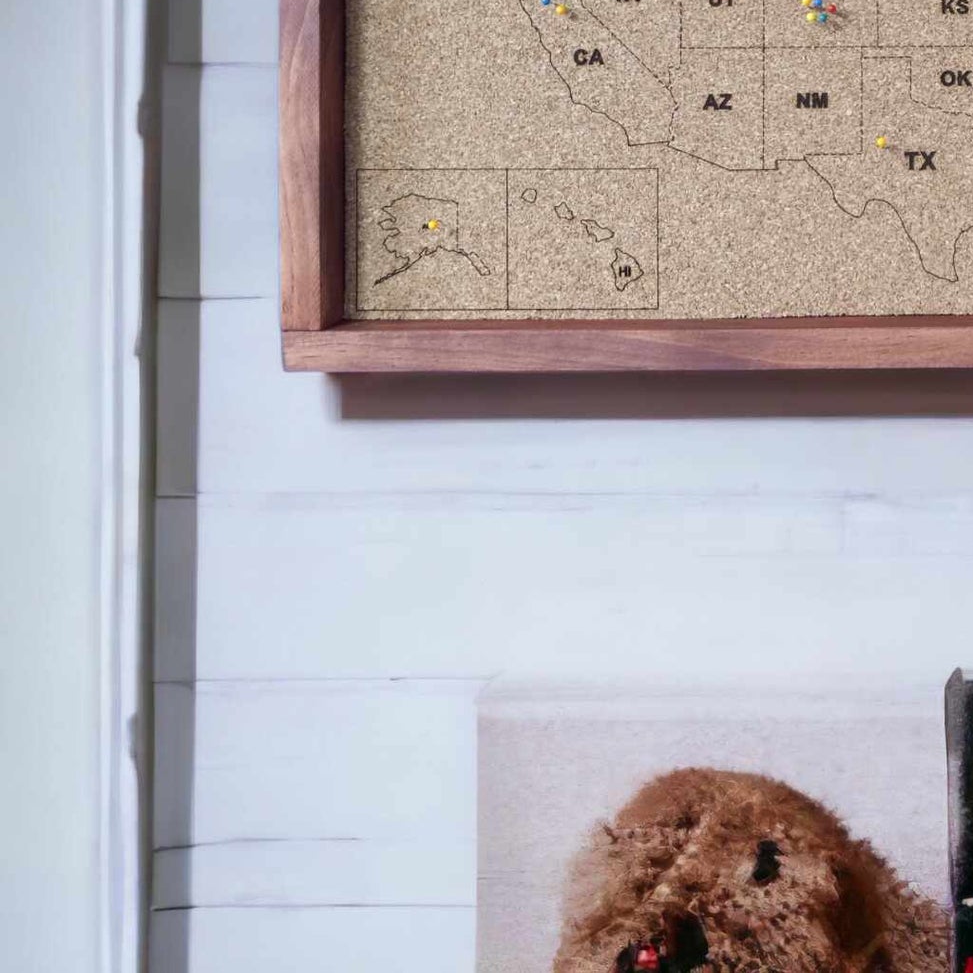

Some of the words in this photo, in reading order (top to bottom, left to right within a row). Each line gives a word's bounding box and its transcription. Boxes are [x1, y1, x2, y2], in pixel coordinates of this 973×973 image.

[573, 48, 604, 66] CA
[940, 70, 972, 87] OK
[703, 93, 732, 110] AZ
[796, 92, 828, 109] NM
[904, 151, 936, 171] TX
[618, 266, 632, 277] HI
